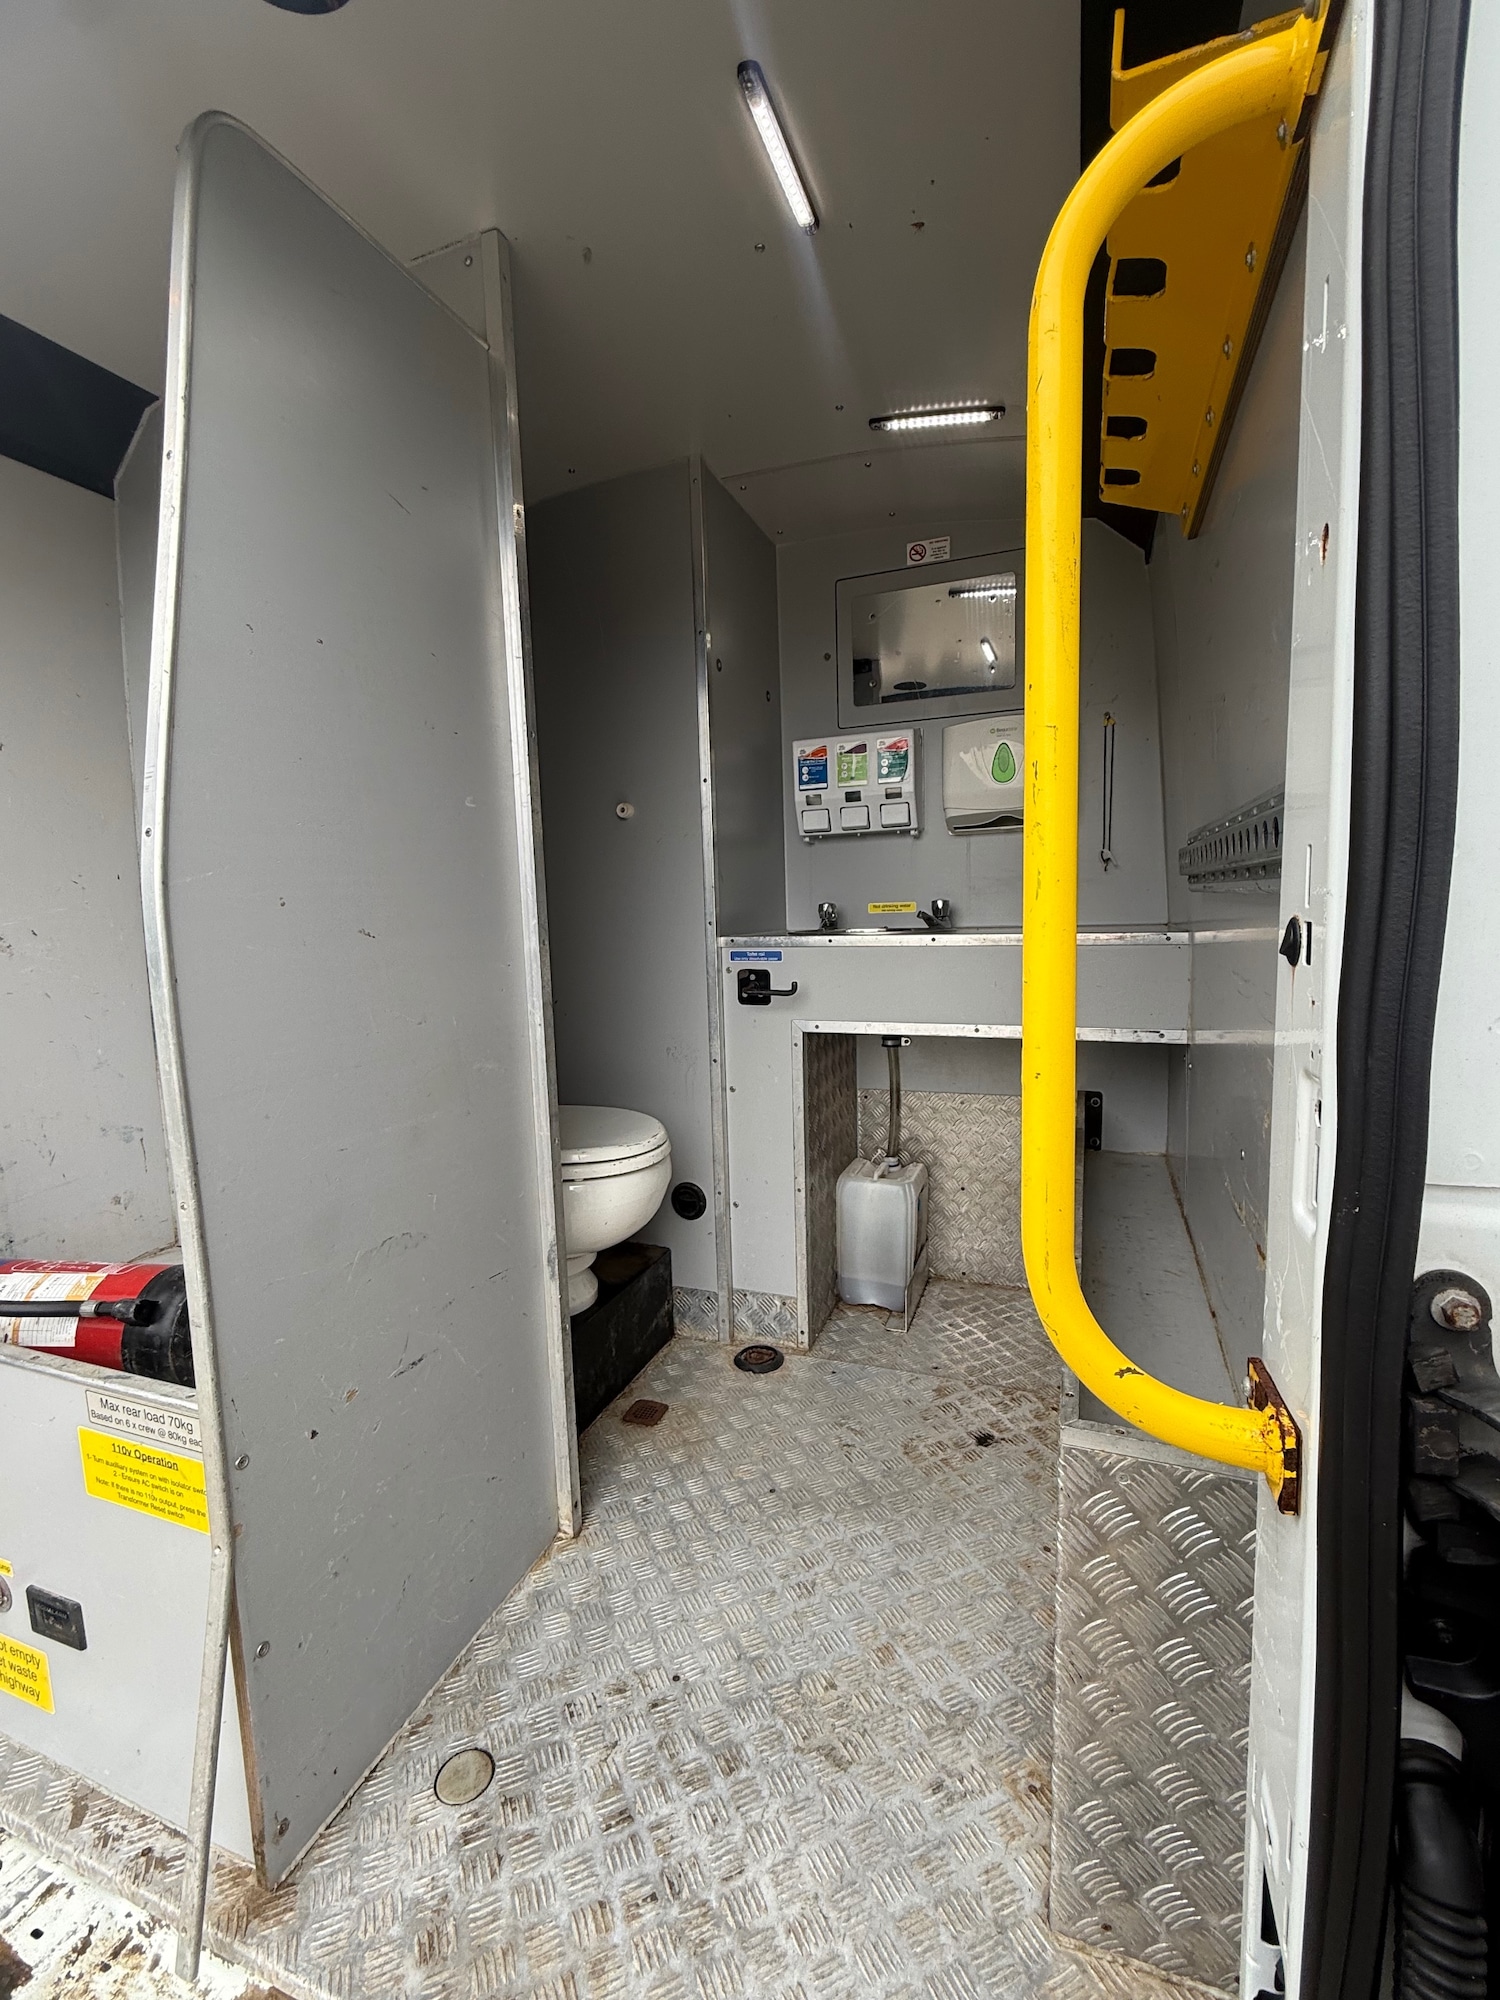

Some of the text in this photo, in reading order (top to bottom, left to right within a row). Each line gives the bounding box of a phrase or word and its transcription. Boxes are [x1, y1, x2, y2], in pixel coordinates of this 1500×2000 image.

[91, 1409, 112, 1423] Based
[115, 1418, 125, 1426] on
[126, 1419, 130, 1427] 6
[138, 1424, 156, 1435] crew
[158, 1428, 166, 1438] @
[168, 1430, 187, 1445] 80kg
[188, 1437, 202, 1448] eac
[100, 1398, 193, 1434] Max rear load 70kg
[112, 1443, 179, 1471] 110v Operation
[92, 1455, 104, 1464] Turn
[106, 1458, 128, 1472] auxiliary
[129, 1465, 148, 1477] system
[158, 1475, 169, 1484] with
[193, 1485, 207, 1496] switc
[122, 1472, 140, 1485] Ensure
[142, 1479, 150, 1487] AC
[151, 1482, 169, 1493] switch
[115, 1483, 129, 1493] there
[180, 1504, 195, 1514] press
[197, 1508, 206, 1518] the
[150, 1502, 166, 1514] Reset
[167, 1509, 185, 1520] switch
[8, 1660, 37, 1682] waste
[10, 1646, 40, 1670] empty
